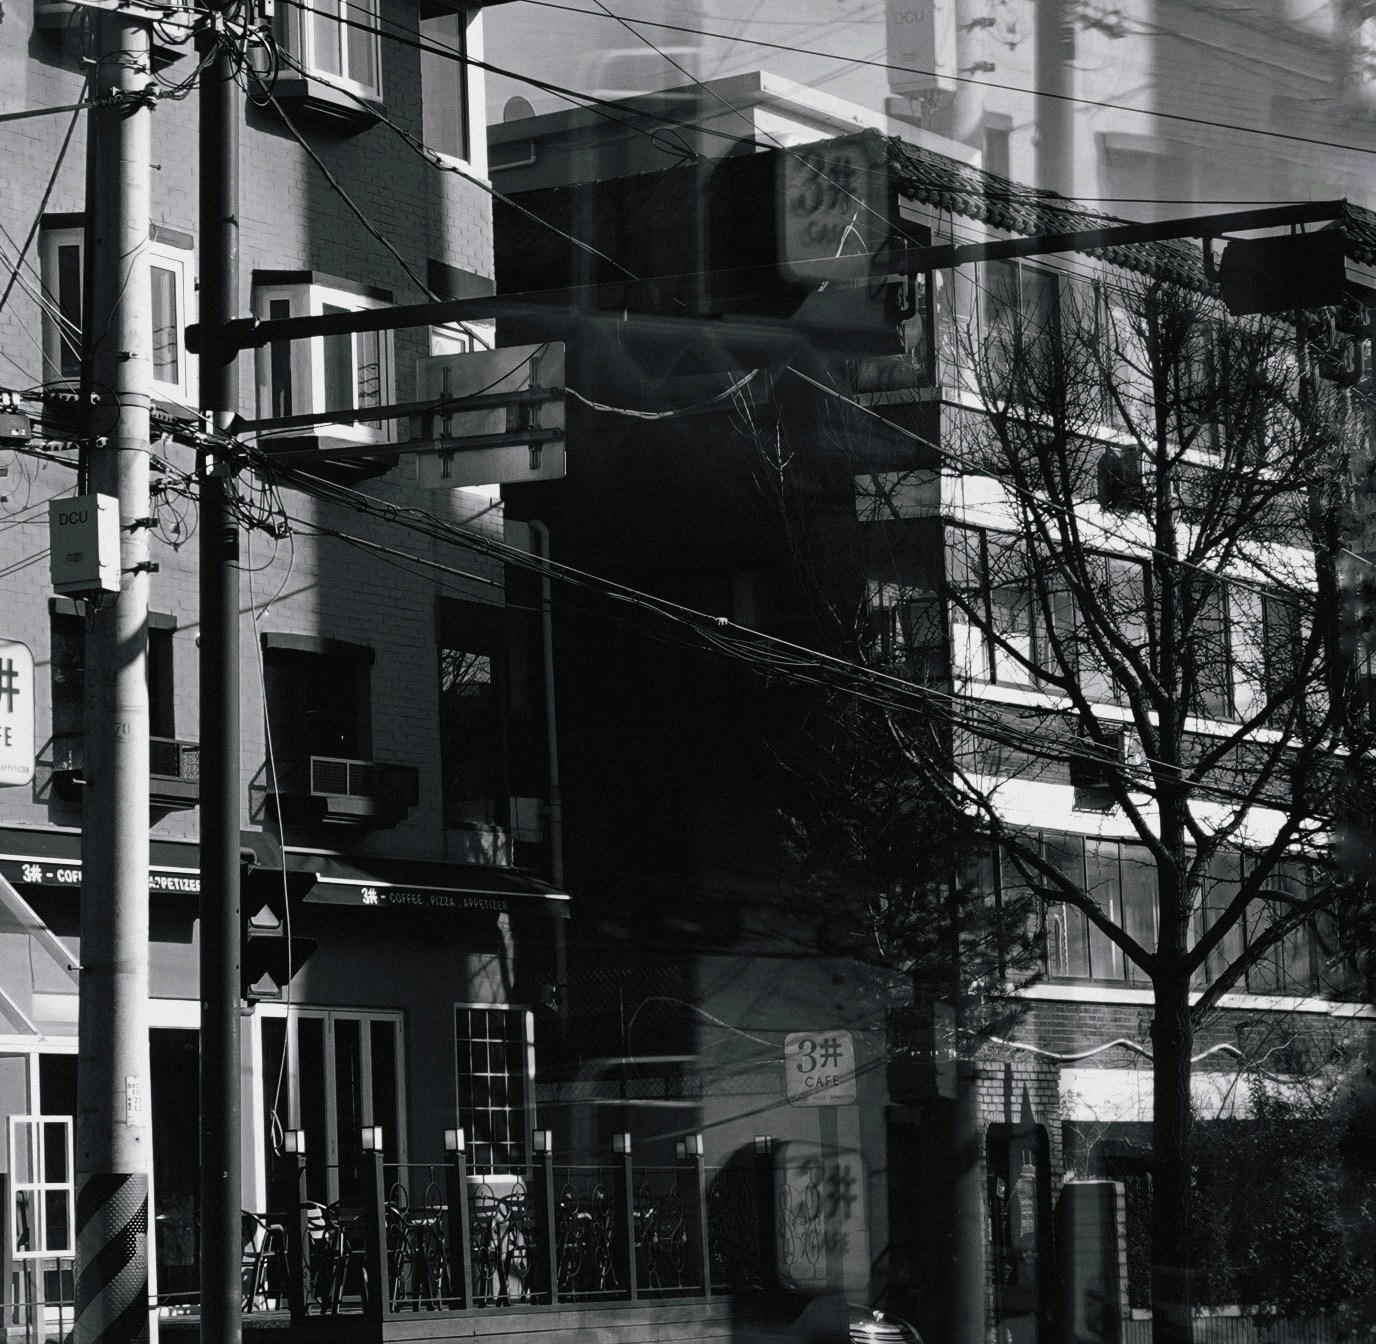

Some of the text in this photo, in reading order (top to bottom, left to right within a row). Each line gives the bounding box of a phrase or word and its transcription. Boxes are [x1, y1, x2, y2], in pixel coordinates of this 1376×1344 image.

[59, 511, 88, 526] DCU
[464, 897, 509, 911] APPETIZER
[805, 1075, 839, 1088] CAFE
